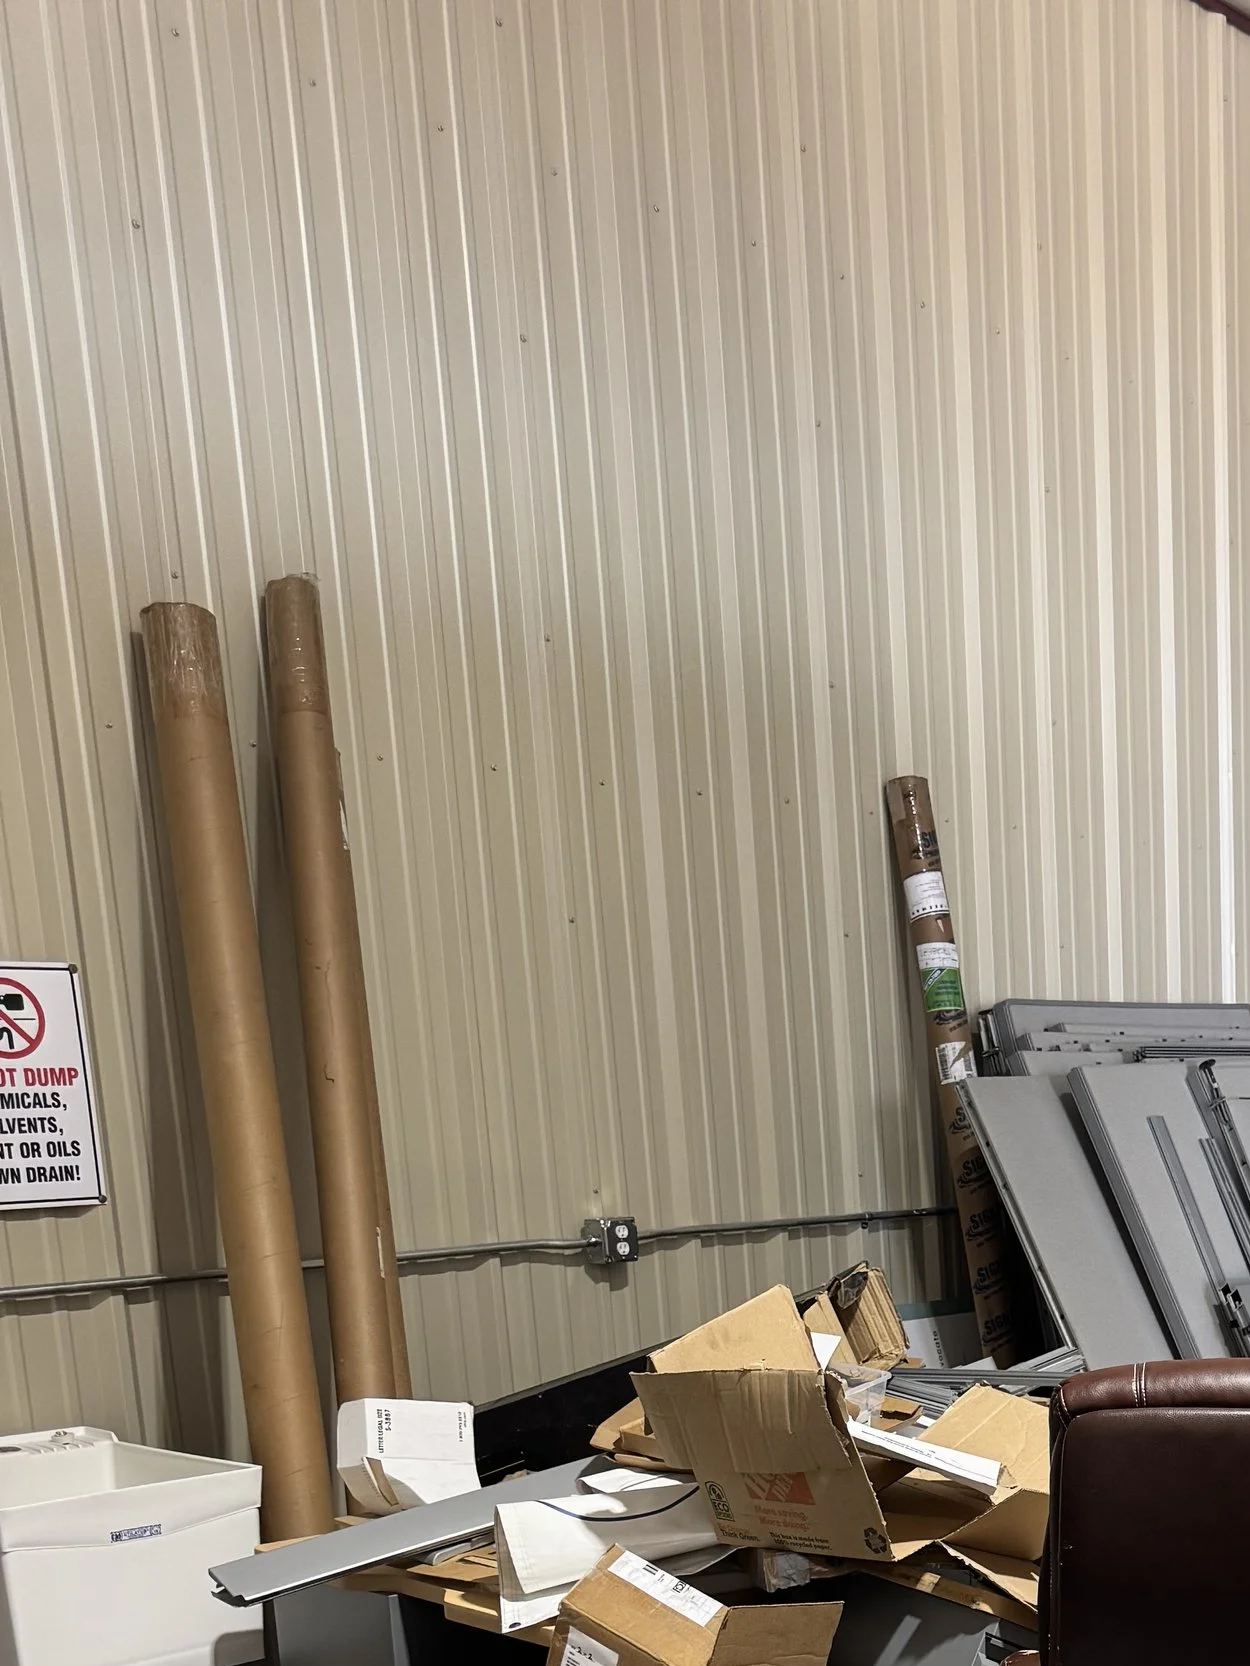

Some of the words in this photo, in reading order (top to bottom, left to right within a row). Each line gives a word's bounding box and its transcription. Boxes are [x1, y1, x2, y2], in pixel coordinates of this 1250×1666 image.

[23, 1067, 79, 1087] DUMP
[0, 1092, 67, 1111] MICALS,
[0, 1116, 64, 1136] LVENTS,
[19, 1142, 42, 1159] OR
[46, 1140, 81, 1158] OILS
[26, 1165, 81, 1183] DRAIN!
[712, 1501, 730, 1513] ECO
